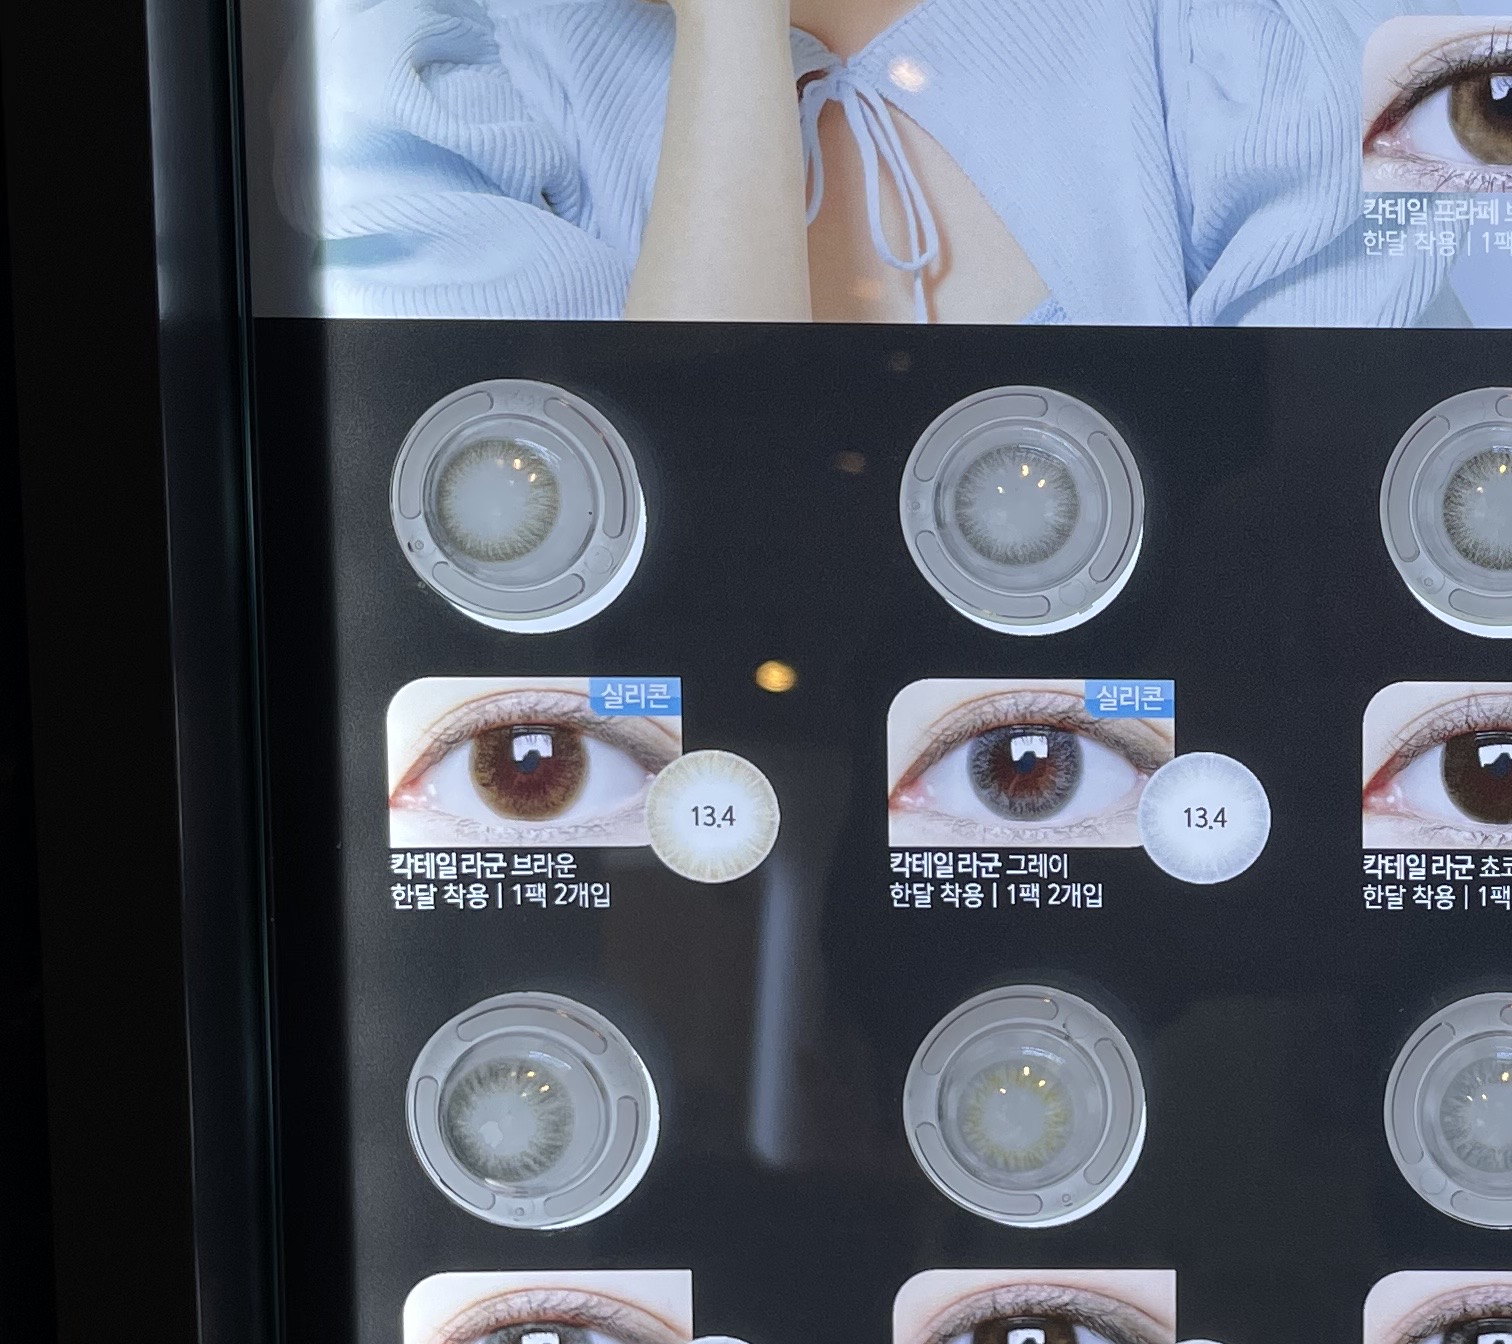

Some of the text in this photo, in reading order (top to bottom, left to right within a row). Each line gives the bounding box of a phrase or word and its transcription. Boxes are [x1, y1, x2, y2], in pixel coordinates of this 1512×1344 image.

[1363, 198, 1427, 226] 칵테일
[1433, 199, 1498, 226] 프라페
[601, 683, 671, 708] 실리콘
[1097, 686, 1164, 712] 실리콘
[691, 805, 736, 828] 13.4
[1184, 807, 1227, 830] 13.4
[390, 852, 577, 879] 칵테일 라군 브라운
[890, 852, 1068, 879] 칵테일 라군 그레이
[1363, 854, 1426, 881] 칵테일
[1431, 855, 1475, 881] 라군
[391, 883, 610, 910] 한달 착용 1팩 2개입
